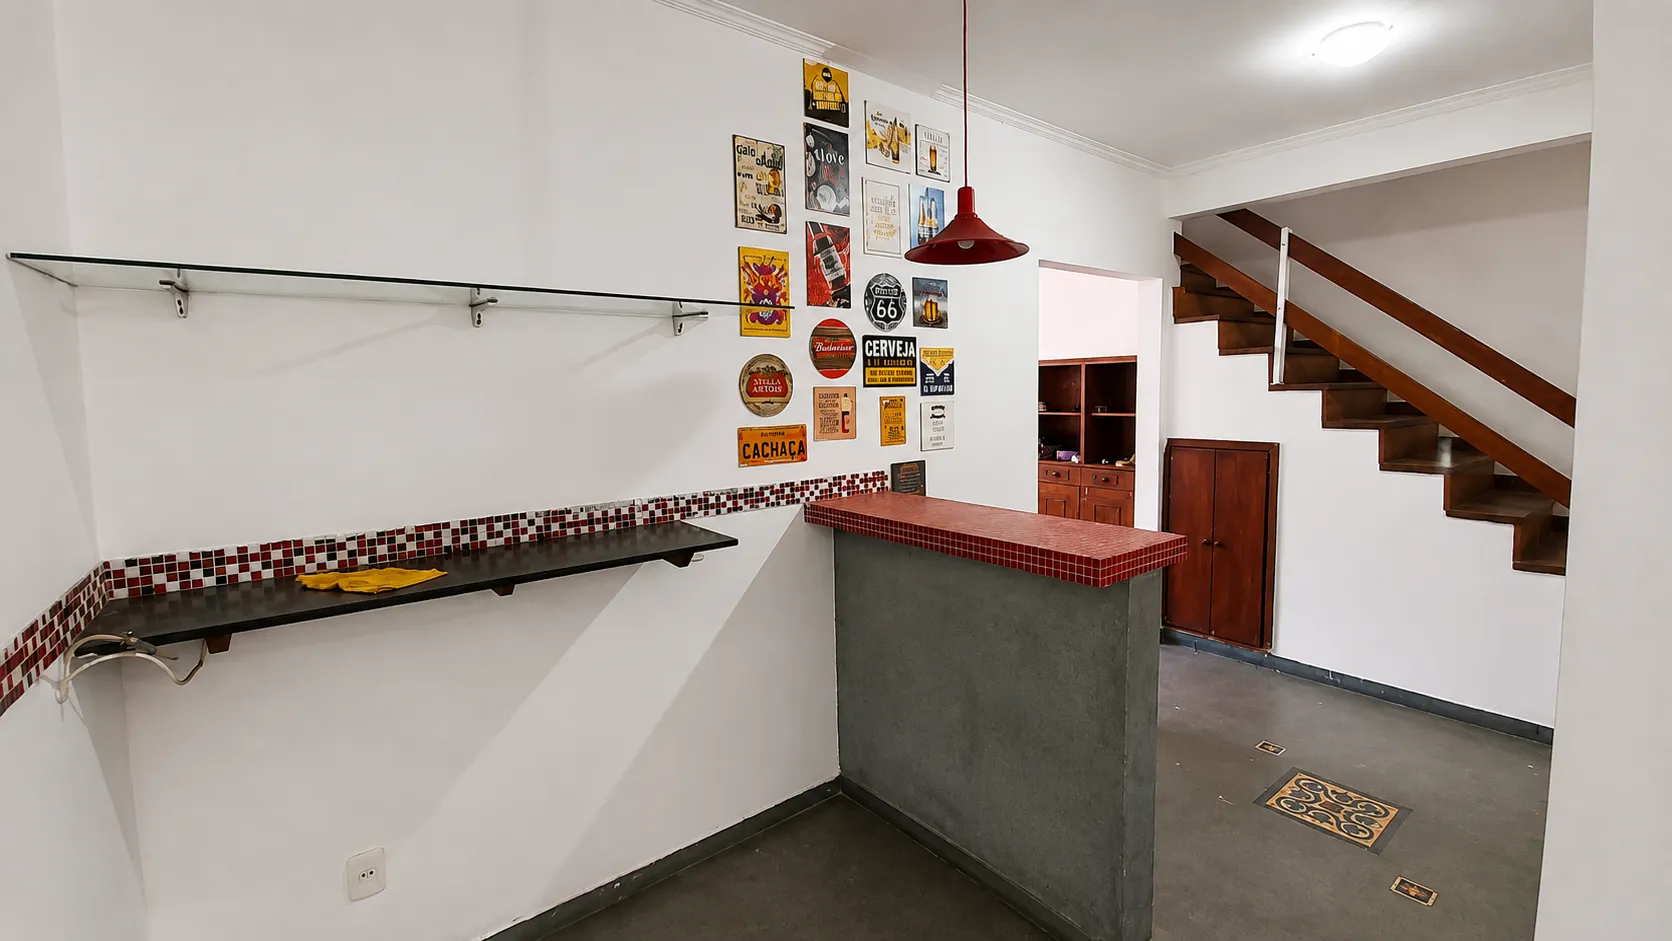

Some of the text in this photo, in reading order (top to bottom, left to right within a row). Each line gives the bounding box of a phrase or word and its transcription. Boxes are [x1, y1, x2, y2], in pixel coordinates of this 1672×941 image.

[877, 299, 898, 319] 66
[865, 339, 916, 358] CERVEJA
[752, 385, 783, 393] ARTOIS
[753, 378, 781, 386] STELLA
[742, 440, 805, 460] CACHAÇA
